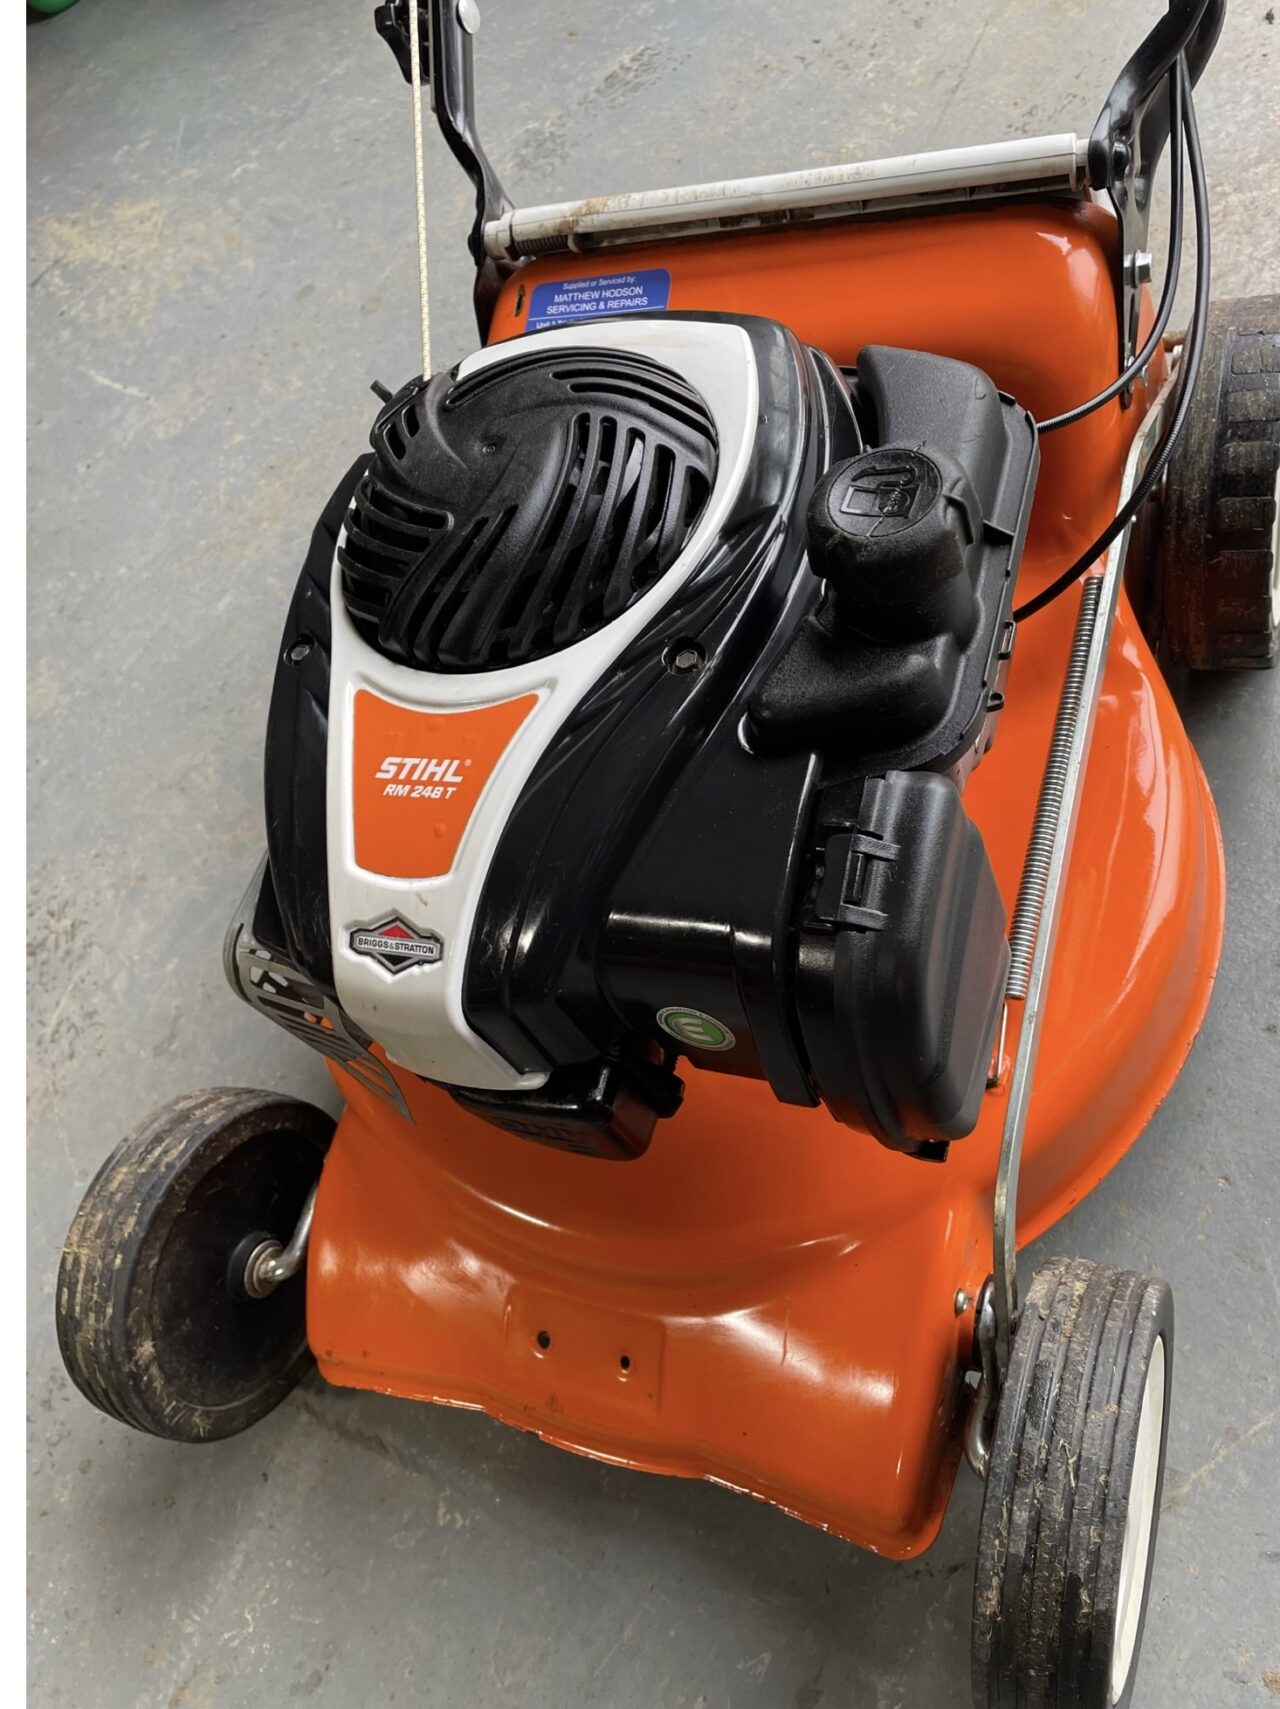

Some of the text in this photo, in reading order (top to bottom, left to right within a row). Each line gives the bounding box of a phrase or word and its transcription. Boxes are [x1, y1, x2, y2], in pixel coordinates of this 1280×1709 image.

[562, 281, 590, 291] Supplied
[598, 277, 626, 287] Serviced
[554, 286, 643, 303] MATTHEW HODSON
[546, 296, 648, 315] SERVICING & REPAIRS
[382, 783, 457, 799] RM 248 T
